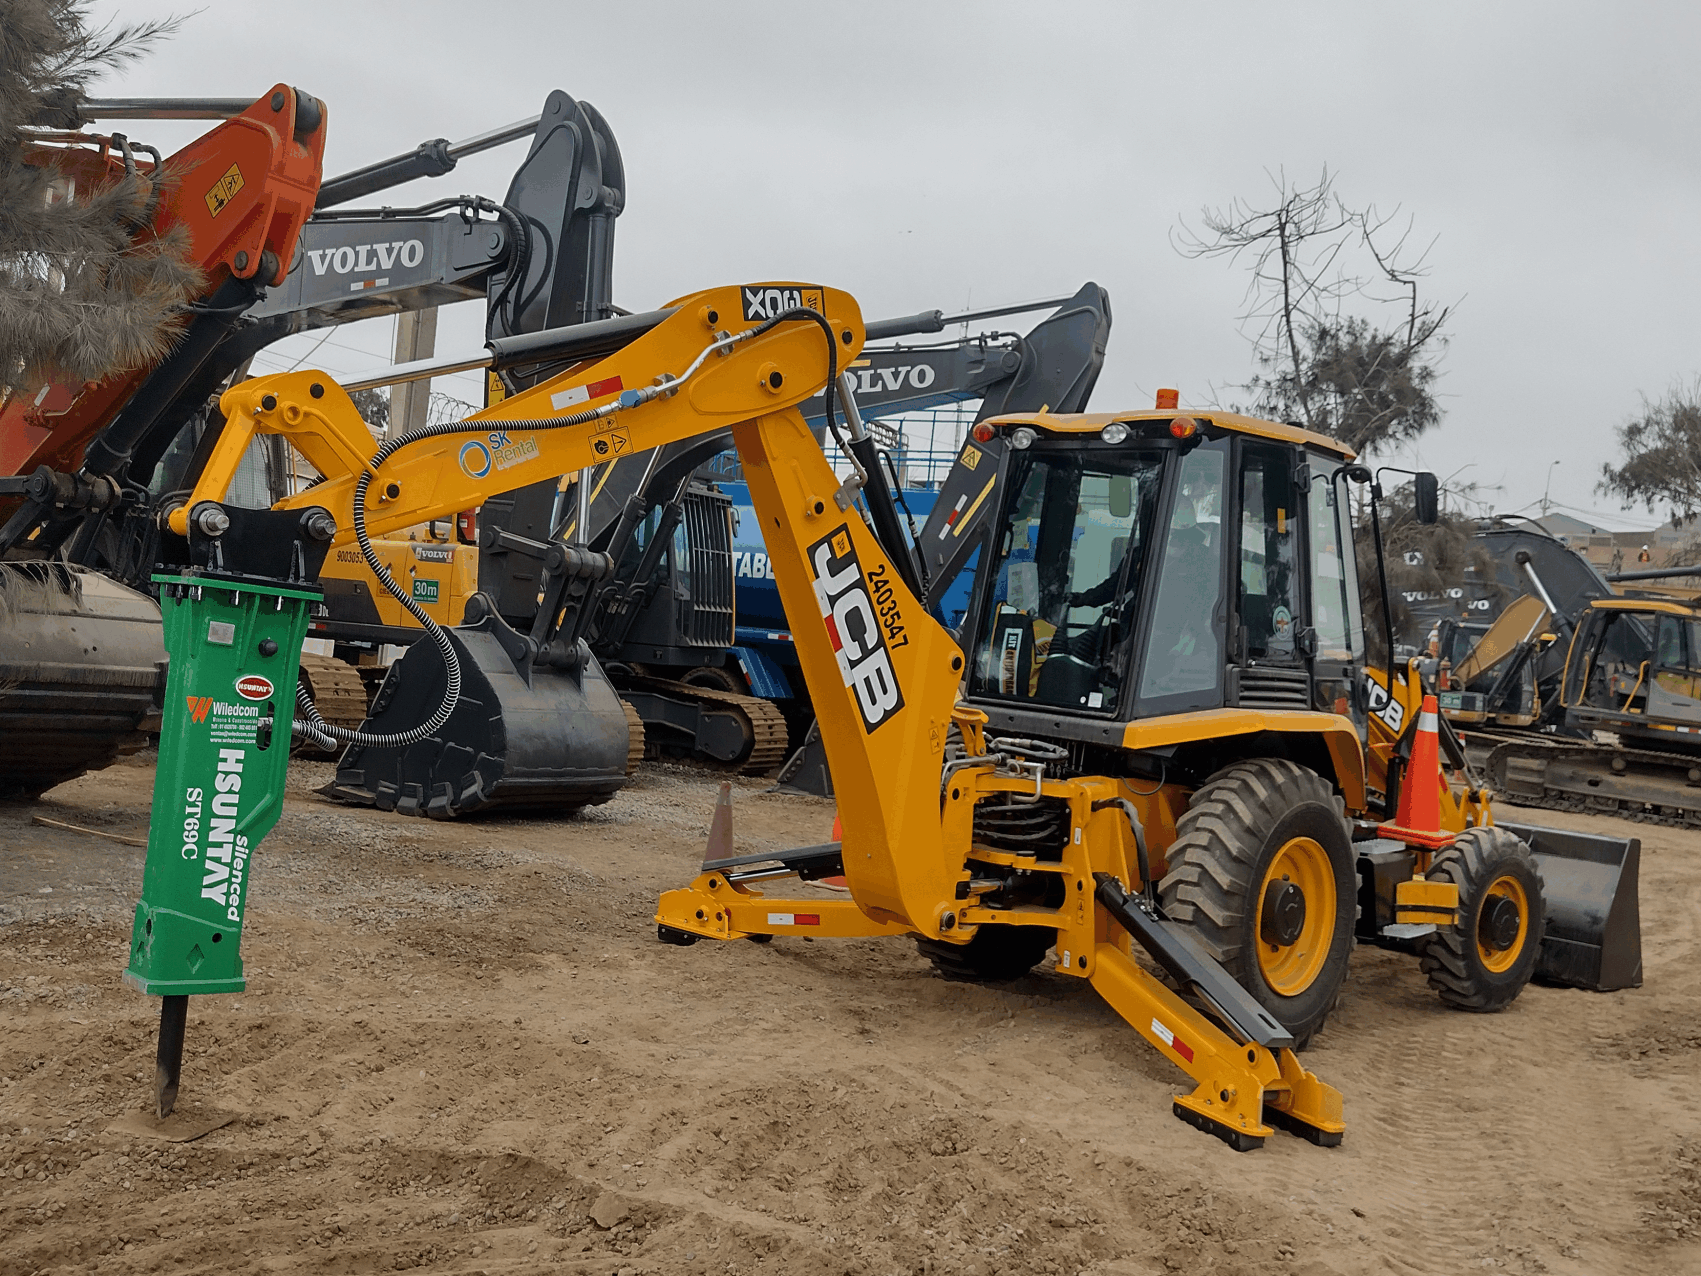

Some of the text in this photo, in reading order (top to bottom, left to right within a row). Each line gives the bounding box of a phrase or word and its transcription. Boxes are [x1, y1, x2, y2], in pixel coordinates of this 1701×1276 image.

[308, 240, 424, 275] VOLVO
[488, 430, 512, 449] SK
[494, 436, 538, 466] Rental
[815, 542, 898, 724] JCB
[867, 564, 909, 650] 2403547
[213, 702, 258, 716] Wiledcom
[182, 787, 203, 860] ST69C
[201, 748, 245, 906] HSUNTAY
[227, 834, 249, 922] silenced
